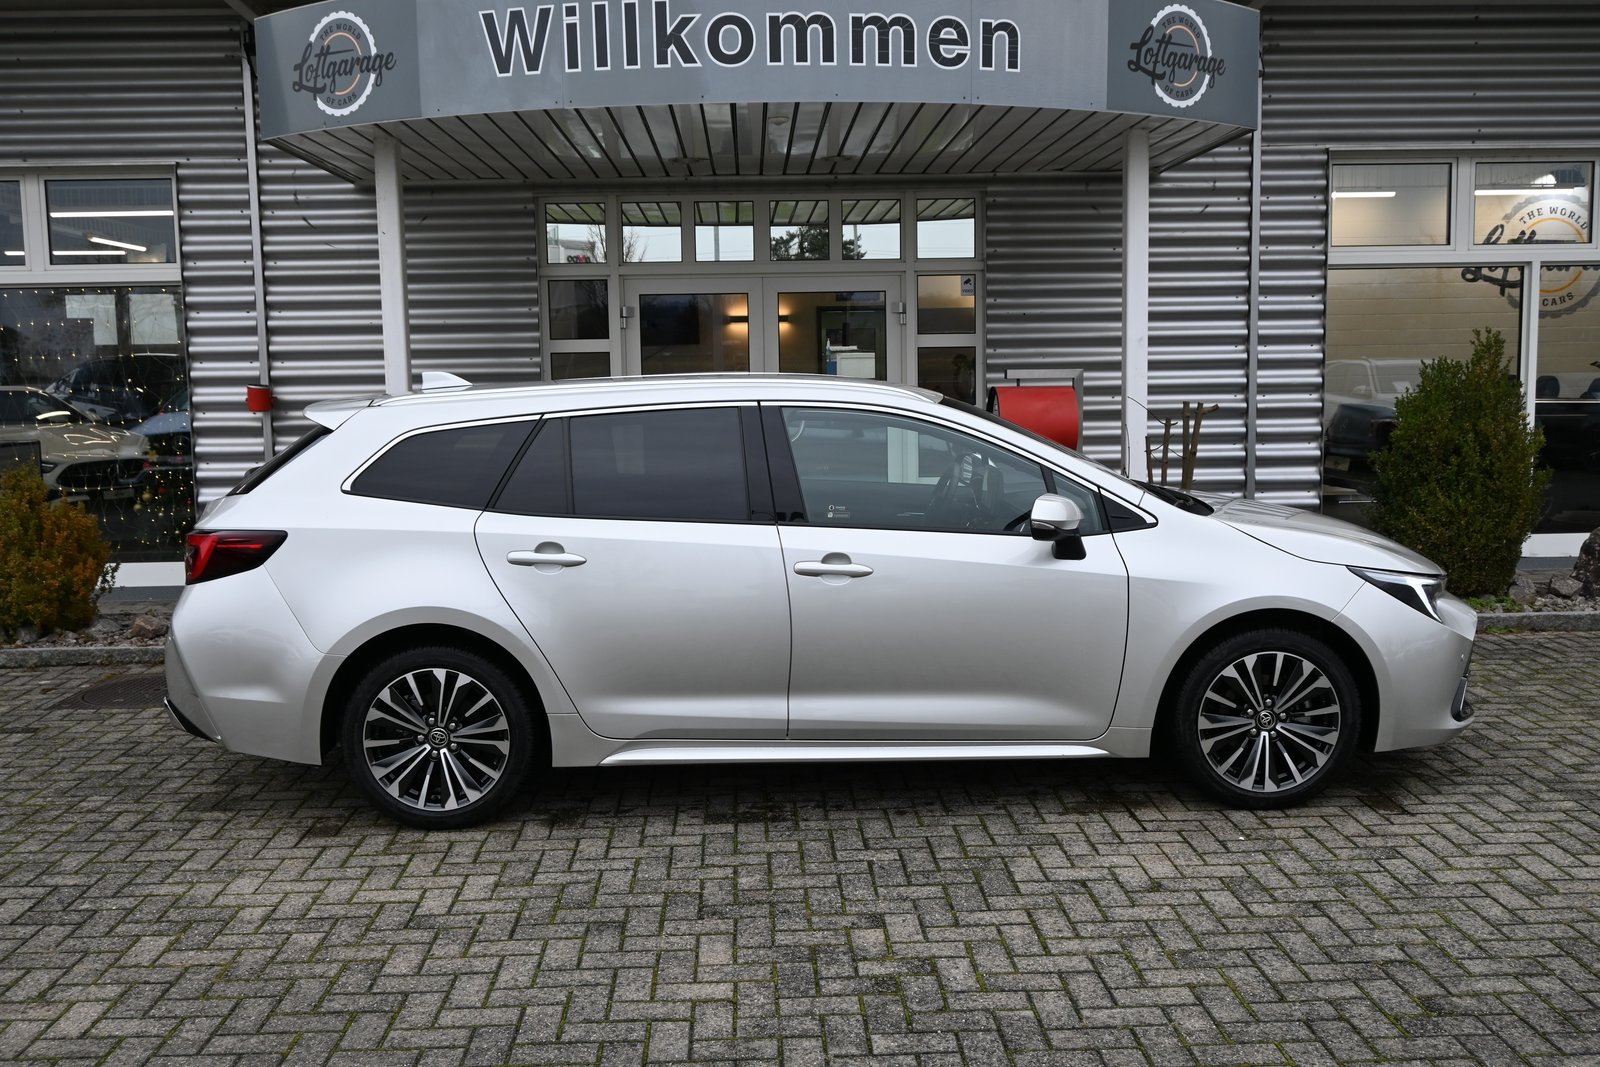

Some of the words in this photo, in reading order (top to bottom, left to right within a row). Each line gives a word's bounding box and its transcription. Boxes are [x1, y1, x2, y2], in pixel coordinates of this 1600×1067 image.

[319, 25, 334, 41] THE
[336, 23, 361, 40] WORLD
[479, 0, 1020, 77] Willkommen
[1162, 16, 1176, 29] THE
[1178, 16, 1201, 39] WORLD
[1127, 25, 1226, 89] Loftgarage
[292, 41, 396, 101] Loftgarage
[326, 96, 336, 106] OF
[338, 92, 357, 106] CARS
[1164, 85, 1174, 95] OF
[1175, 87, 1194, 98] CARS
[1519, 207, 1544, 225] THE
[1549, 206, 1588, 230] WORLD
[1542, 291, 1574, 307] CARS
